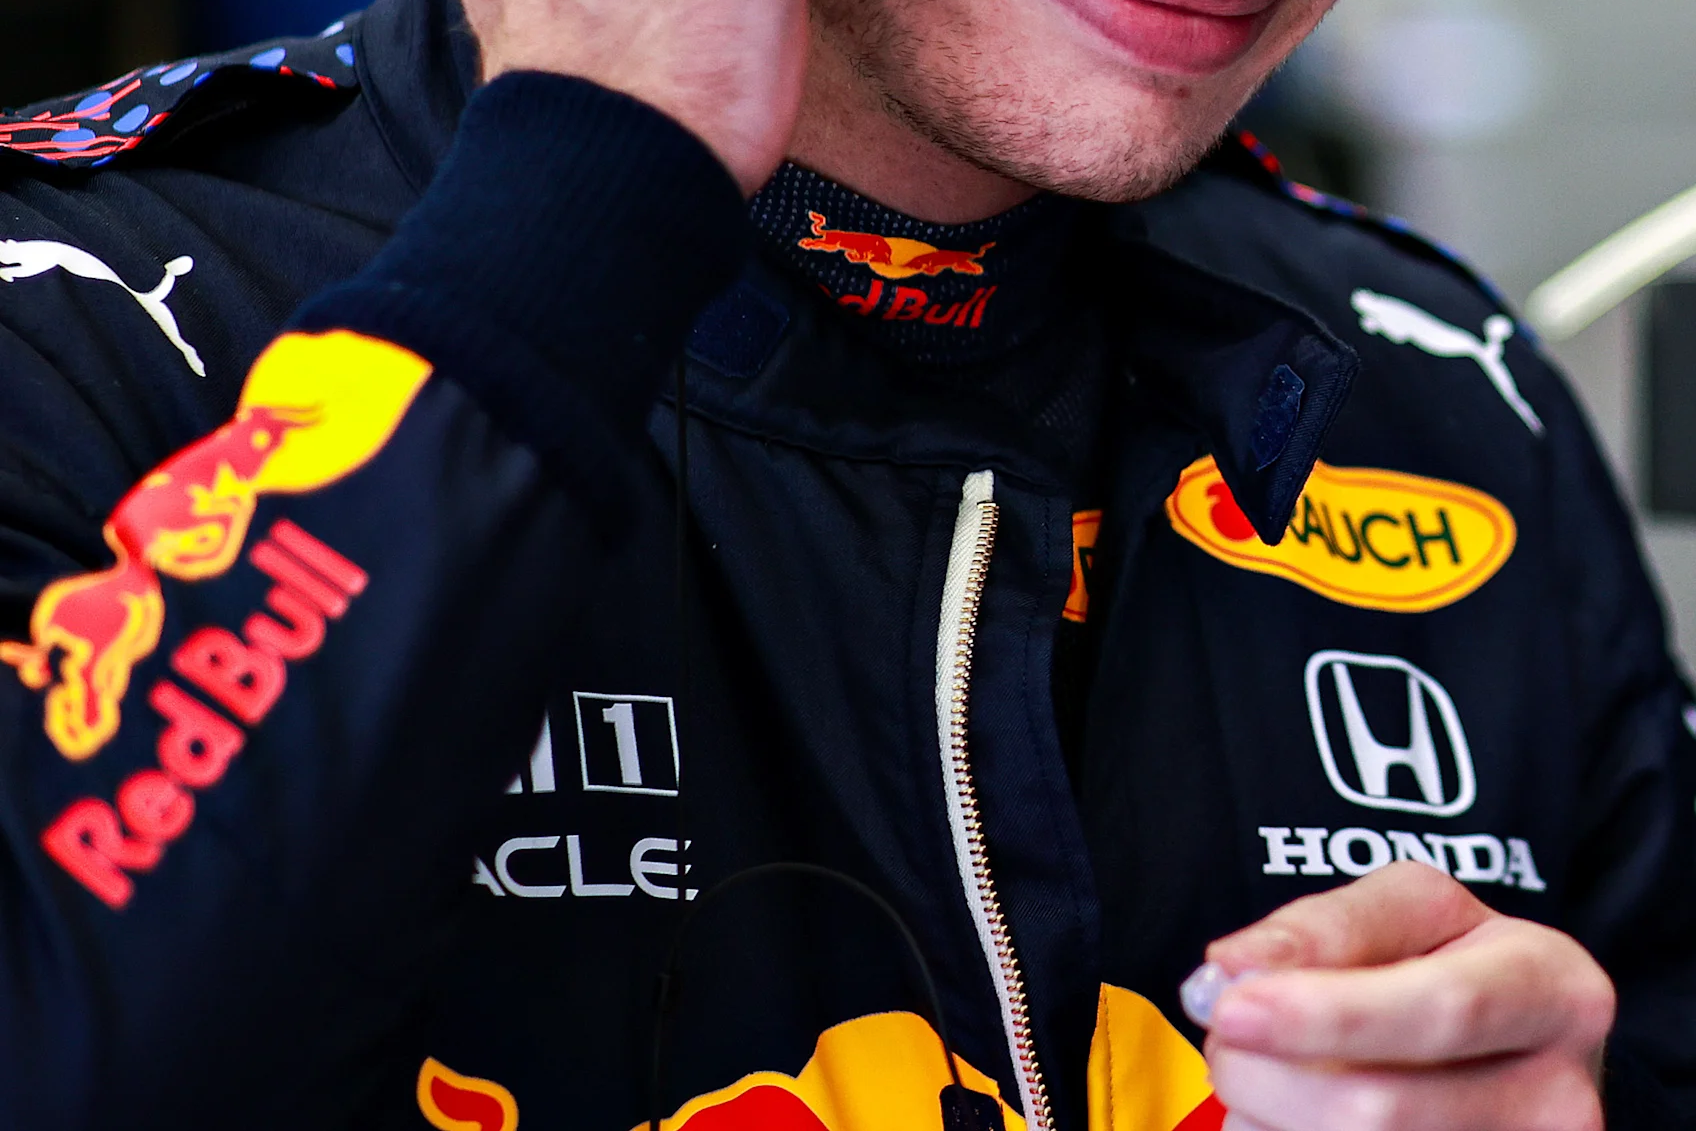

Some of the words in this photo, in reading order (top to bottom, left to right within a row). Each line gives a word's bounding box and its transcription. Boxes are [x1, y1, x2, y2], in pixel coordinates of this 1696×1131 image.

[882, 284, 998, 328] Bull
[1289, 494, 1463, 569] AUCH
[1257, 826, 1547, 892] HONDA
